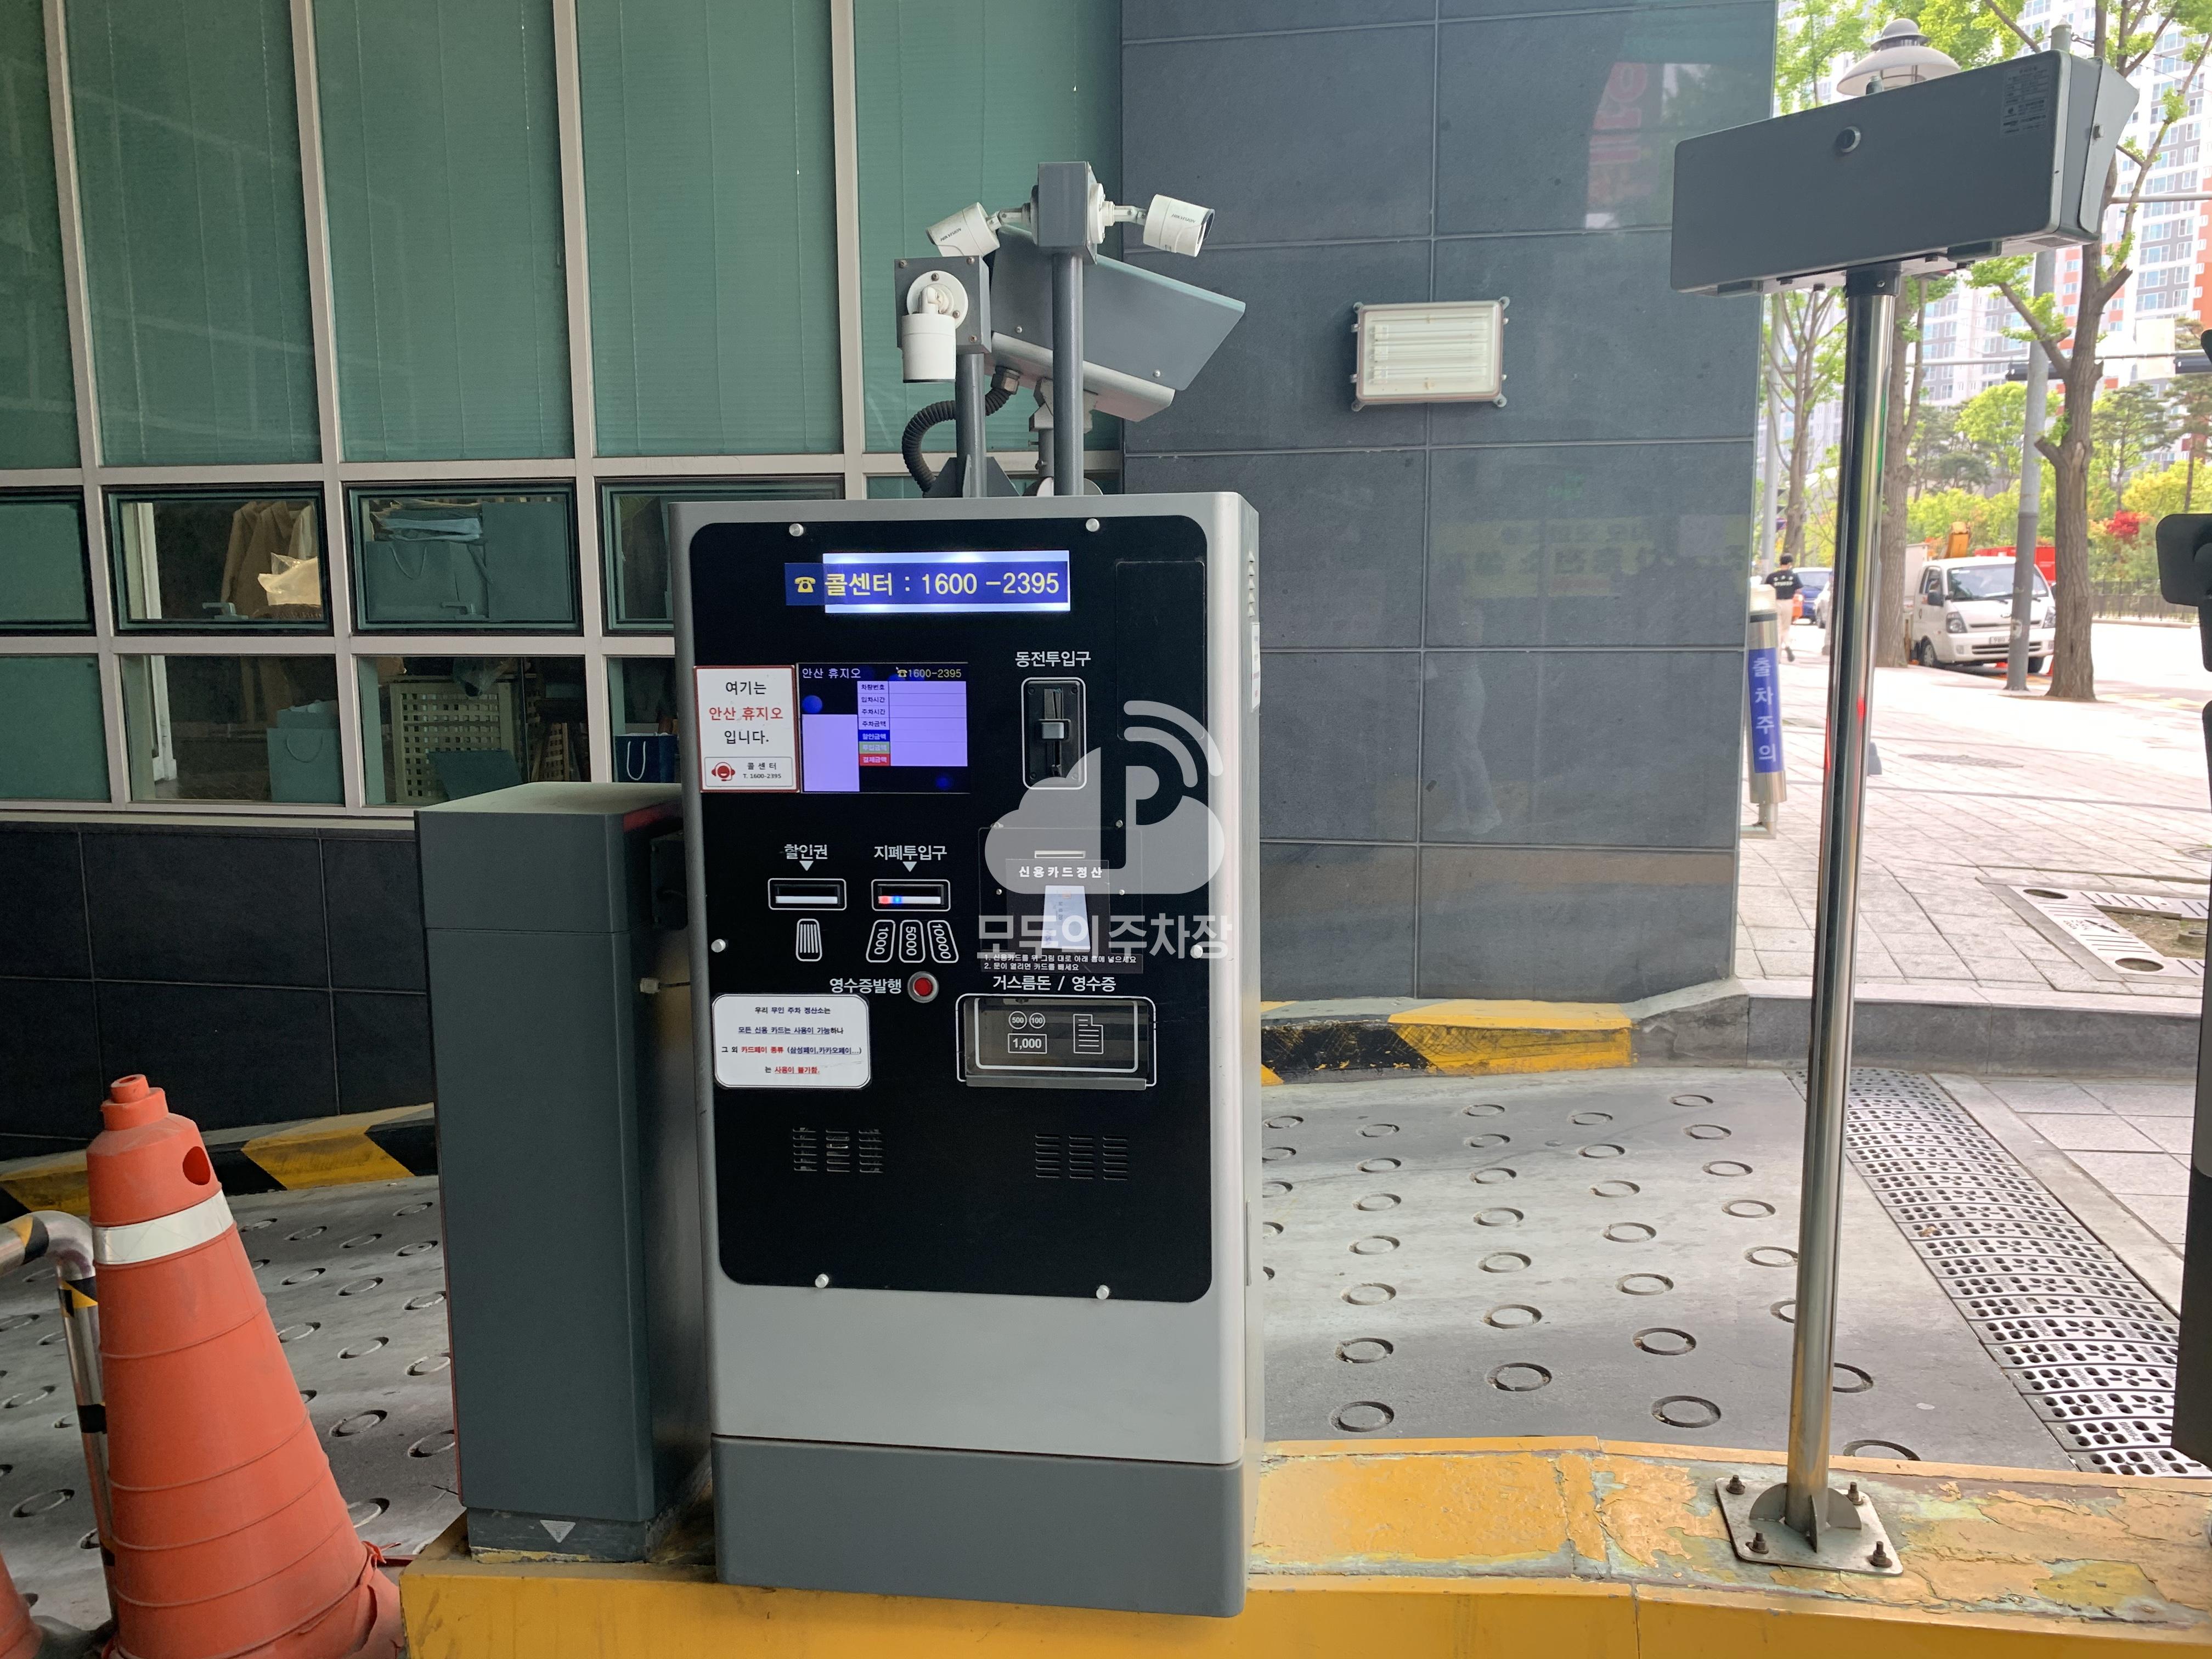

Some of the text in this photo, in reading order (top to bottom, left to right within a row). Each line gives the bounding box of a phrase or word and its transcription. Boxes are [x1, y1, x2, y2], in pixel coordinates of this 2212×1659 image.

[825, 573, 893, 596] 콜센터
[1015, 651, 1091, 667] 동전투입구
[802, 668, 861, 679] 안산 휴지오
[908, 669, 962, 678] 1600-2395
[726, 681, 766, 695] 여기는
[709, 707, 783, 720] 안산 휴지오
[724, 730, 769, 744] 입니다.
[785, 844, 828, 860] 할인권
[874, 845, 947, 860] 지폐투입구
[874, 927, 889, 955] 1000
[906, 926, 917, 956] 5000
[932, 924, 952, 960] 10000
[830, 978, 901, 994] 영수증발행
[993, 975, 1051, 991] 거스름돈
[1071, 976, 1116, 992] 영수증
[1013, 1038, 1041, 1049] 1,000
